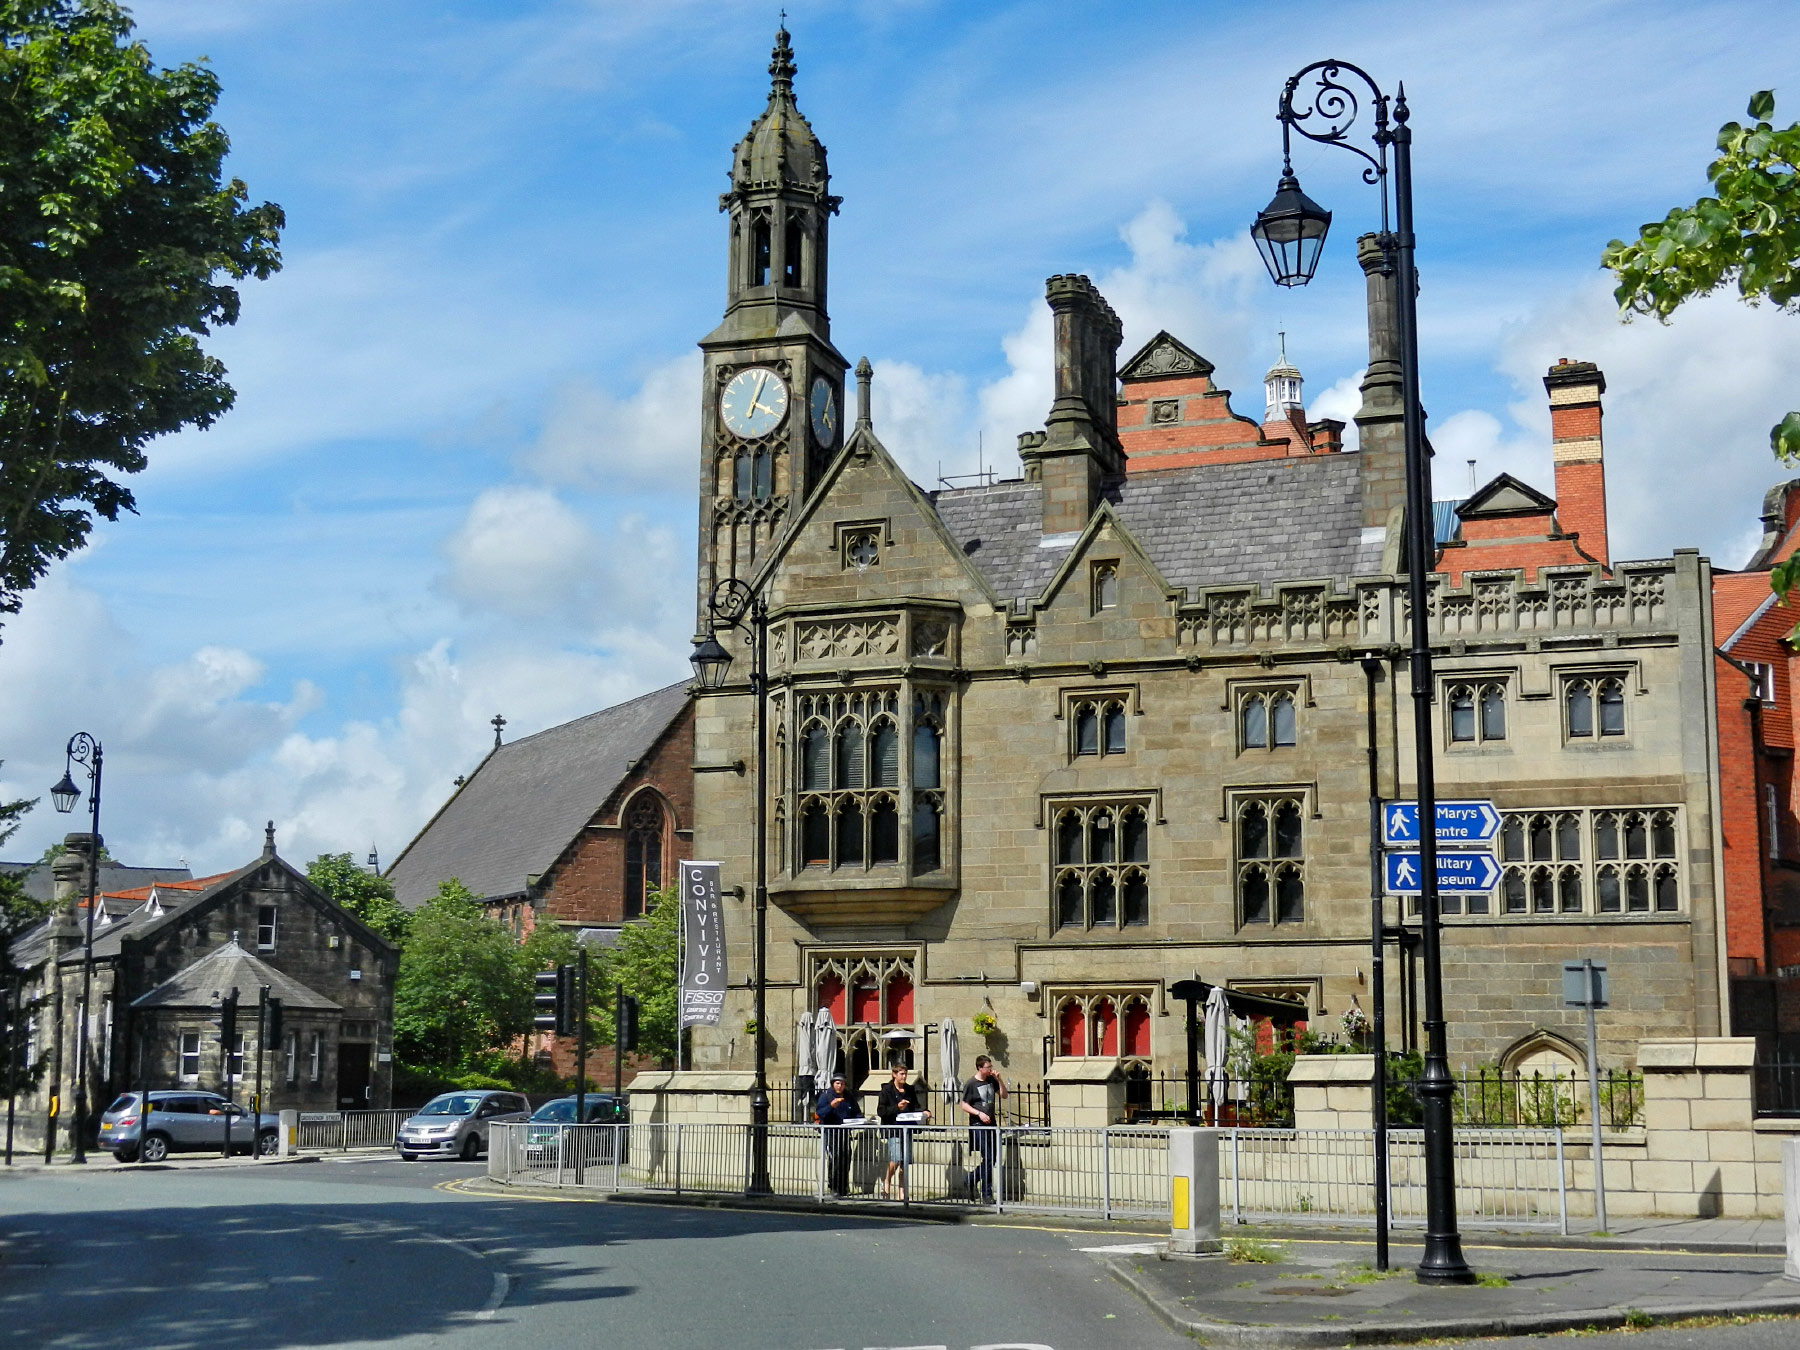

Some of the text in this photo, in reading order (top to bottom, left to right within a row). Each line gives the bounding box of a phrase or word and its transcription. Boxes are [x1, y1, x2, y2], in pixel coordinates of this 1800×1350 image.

[1436, 807, 1477, 820] Mary's
[1435, 826, 1468, 837] entre
[1436, 857, 1473, 871] ilitary
[1437, 876, 1476, 885] useum
[691, 869, 709, 985] CONVIVIO
[712, 911, 722, 974] RESTAURANT
[684, 992, 723, 1003] FISSO
